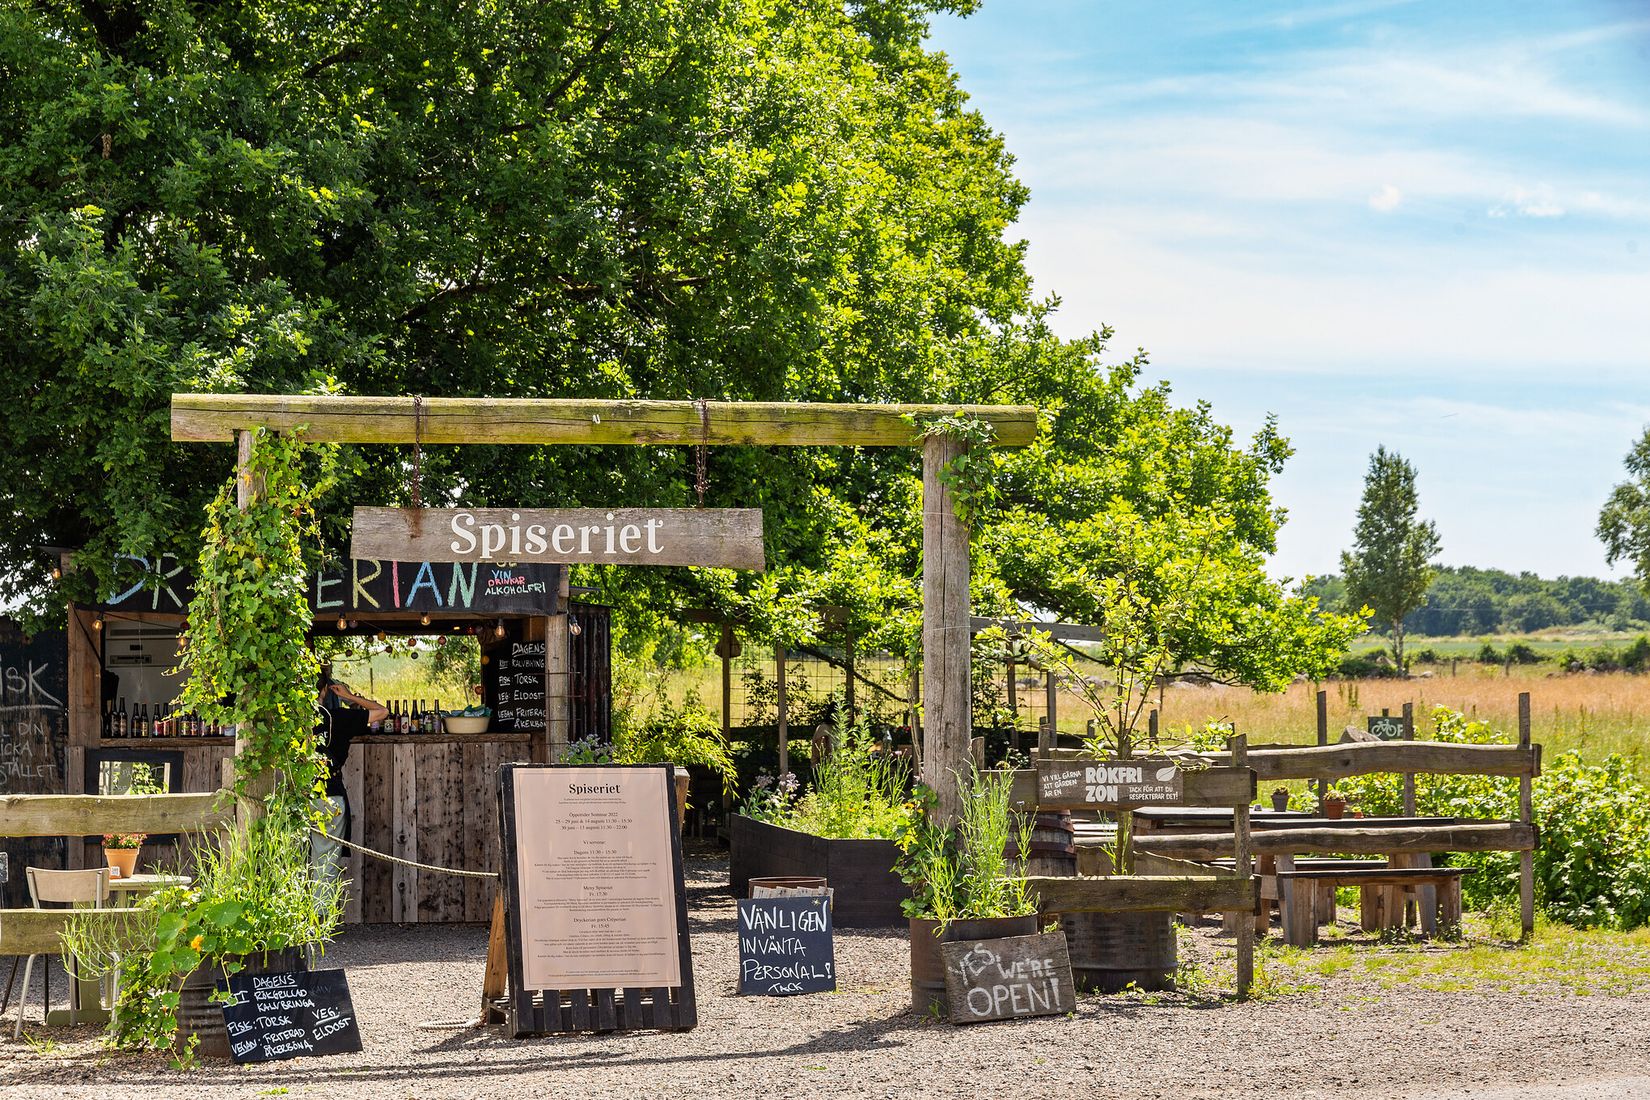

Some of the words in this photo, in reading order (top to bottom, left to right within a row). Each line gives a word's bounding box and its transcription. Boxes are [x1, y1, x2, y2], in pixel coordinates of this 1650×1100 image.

[450, 513, 665, 559] Spiseriet
[487, 576, 526, 588] DRINKAR
[491, 570, 512, 580] VIN
[484, 581, 547, 596] ALKOHOLFRI
[512, 642, 546, 656] DAGENS
[512, 659, 545, 668] KALVBRING
[514, 673, 539, 685] TORSK
[19, 721, 45, 738] DIN
[1050, 773, 1061, 781] VILL
[1062, 771, 1082, 780] GÄRNA
[1085, 763, 1143, 785] RÖKFRI
[569, 783, 621, 795] Spiseriet
[1054, 779, 1078, 789] GÅRDEN
[1044, 790, 1053, 798] ÄR
[1085, 785, 1119, 803] ZON
[1166, 791, 1179, 800] DET!
[740, 900, 828, 934] VÄNLIGEN
[742, 935, 806, 957] INVÄNTA
[743, 958, 832, 982] PERSONAL!
[996, 957, 1057, 980] WE'RE
[253, 974, 297, 989] DAGENS
[768, 982, 804, 993] TACK
[254, 988, 308, 1001] RÖKGRILLAD
[967, 978, 1063, 1017] OPEN!
[312, 1006, 340, 1021] VEG:
[226, 1020, 258, 1035] FISK:
[256, 1015, 293, 1030] TORSK
[312, 1017, 352, 1041] ELDOST
[231, 1038, 263, 1055] VEGAN:
[263, 1028, 306, 1045] FRITERAD
[264, 1039, 314, 1058] ÅKERBÖNA
